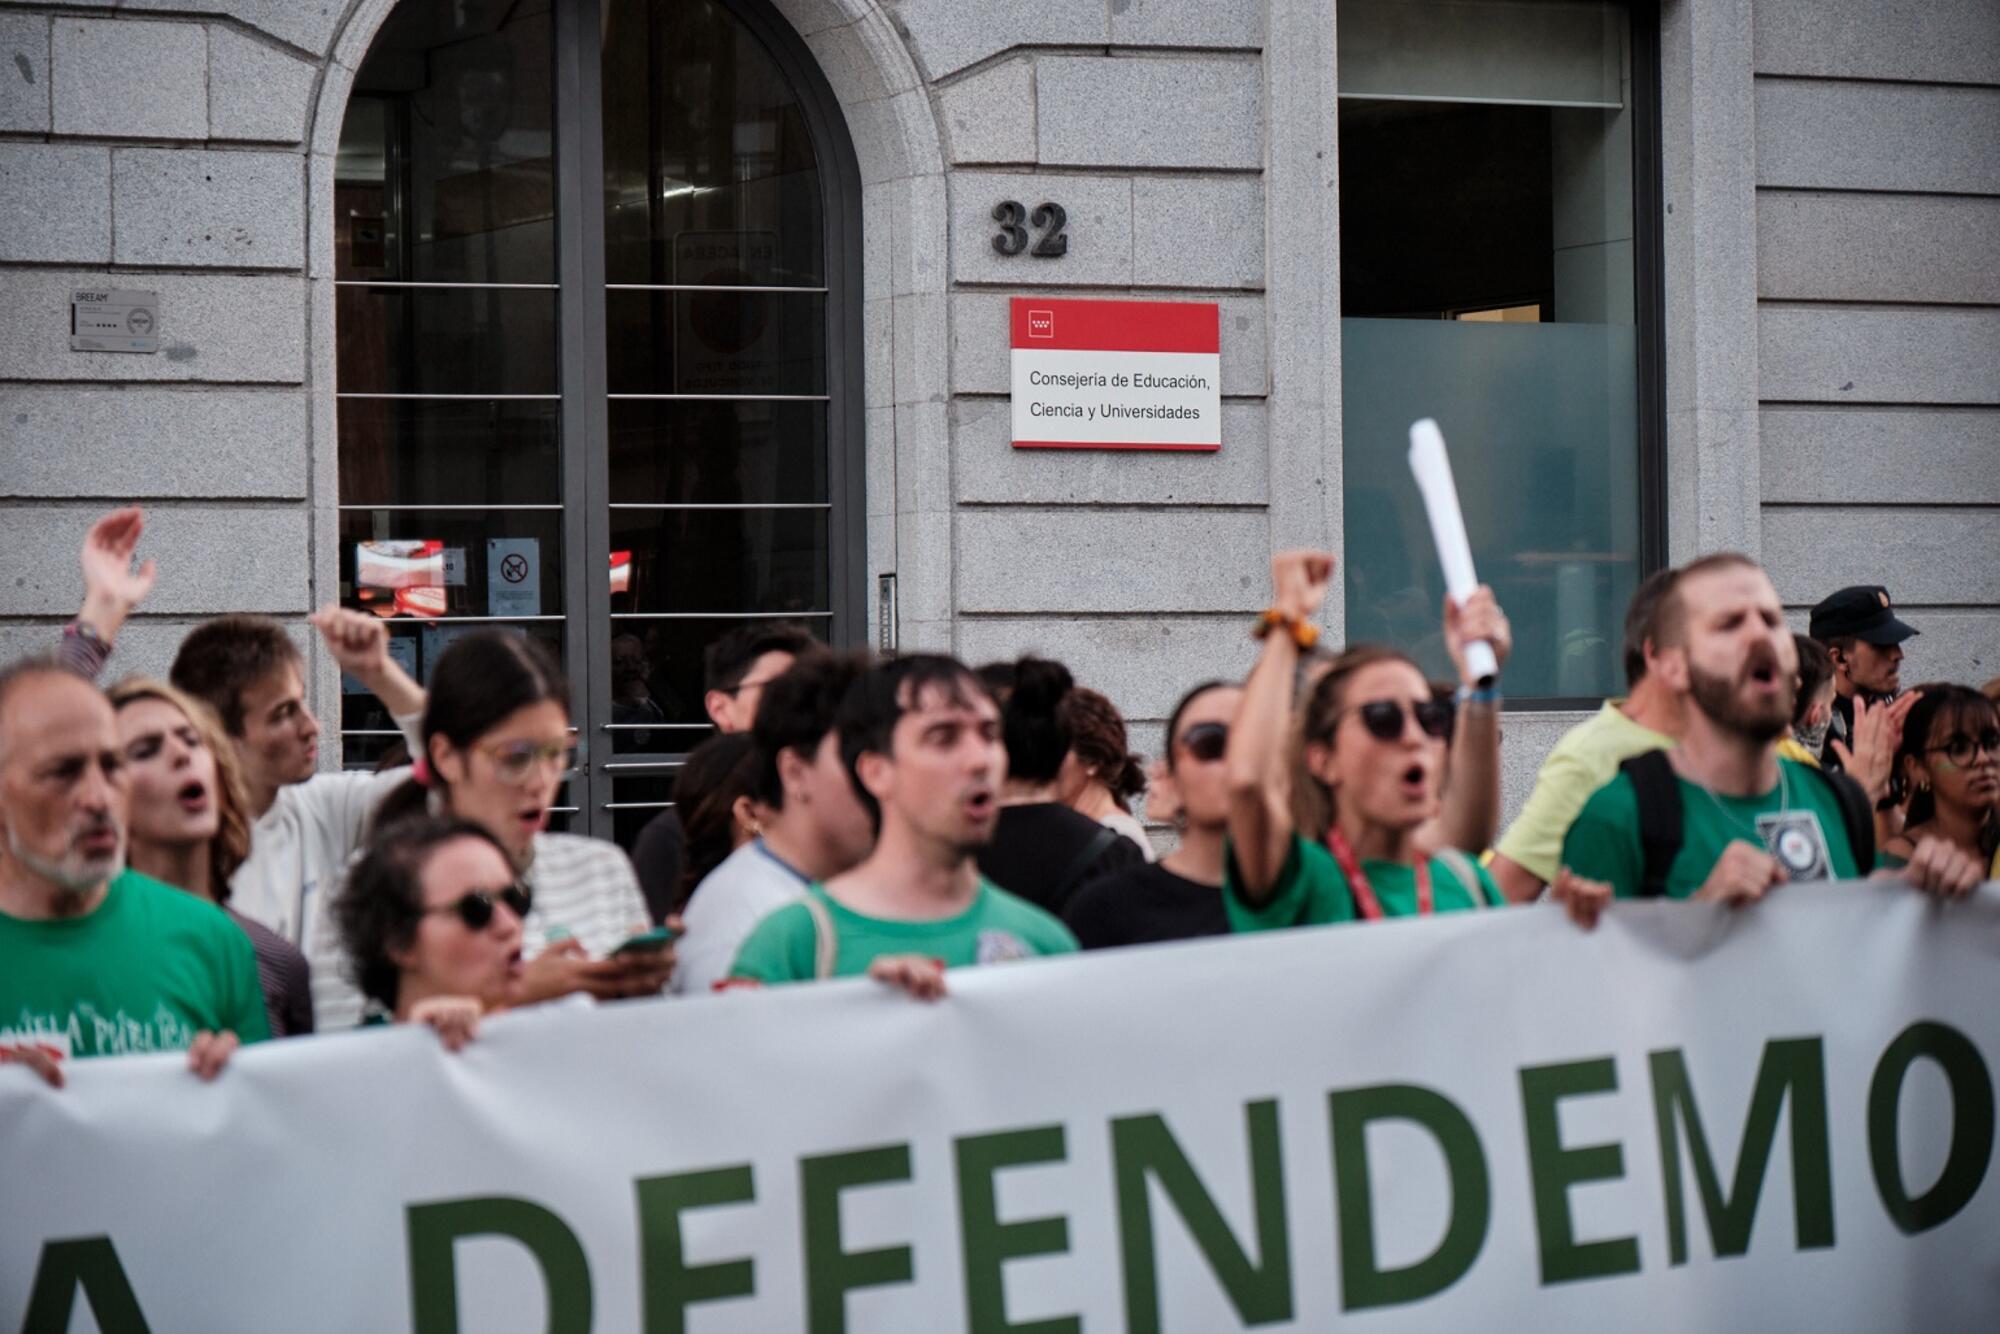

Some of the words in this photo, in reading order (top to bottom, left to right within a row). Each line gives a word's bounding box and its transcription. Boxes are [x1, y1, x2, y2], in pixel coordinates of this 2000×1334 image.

[991, 200, 1068, 258] 32
[1030, 370, 1107, 389] Consejería
[1111, 372, 1129, 387] de
[1133, 373, 1210, 391] Educación,
[1030, 402, 1083, 417] Ciencia
[1088, 406, 1096, 421] y
[1100, 404, 1200, 419] Universidades
